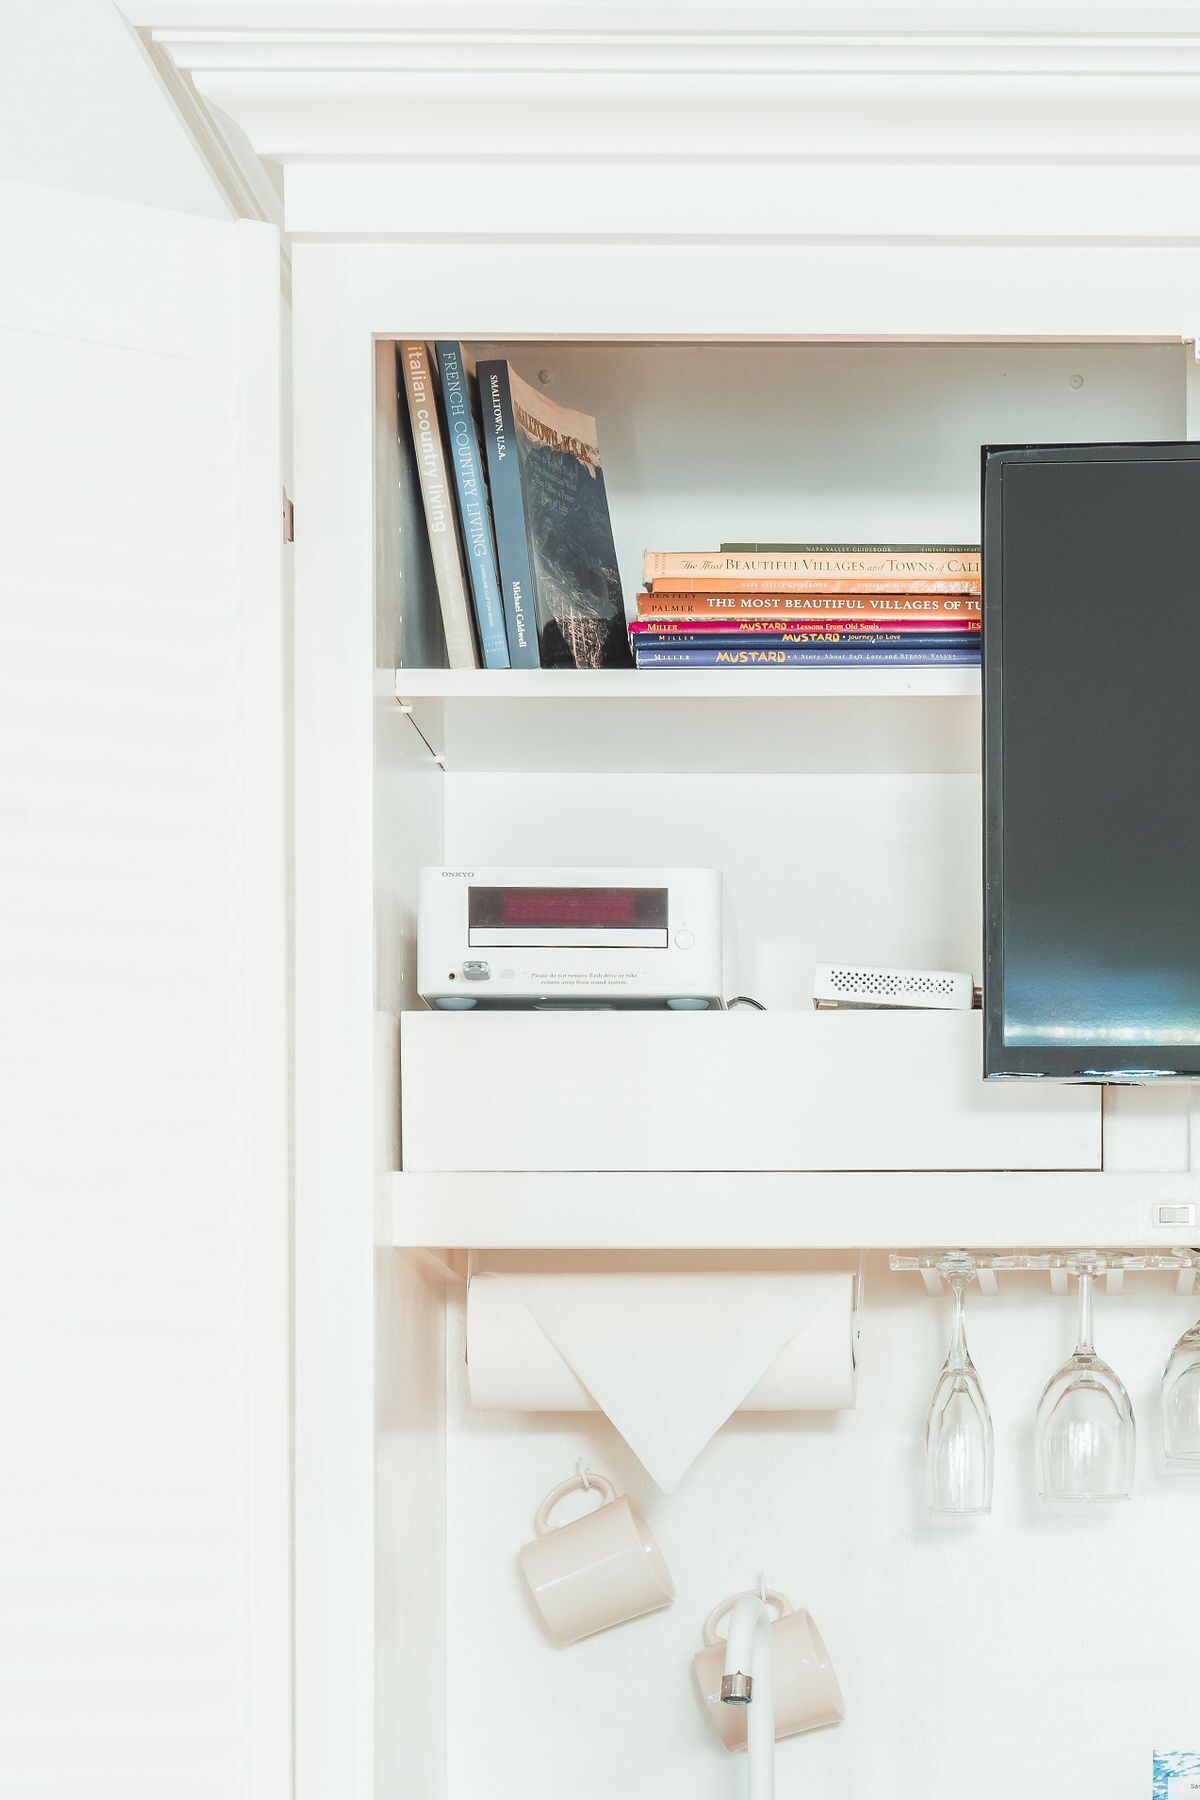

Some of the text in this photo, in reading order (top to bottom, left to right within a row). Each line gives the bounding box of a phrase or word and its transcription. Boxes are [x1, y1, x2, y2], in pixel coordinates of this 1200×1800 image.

[490, 374, 507, 461] SMALLTOWN, U.S.A.
[407, 346, 447, 533] italian country living
[443, 351, 488, 558] FRENCH COUNTRY LIVING
[681, 560, 698, 570] The
[699, 560, 723, 570] Most
[725, 559, 801, 571] BEAUTIFUL
[803, 559, 865, 571] VILLAGES
[866, 563, 885, 572] and
[886, 559, 935, 572] TOWNS
[936, 563, 945, 574] of
[706, 598, 736, 608] THE
[740, 599, 780, 608] MOST
[785, 599, 865, 609] BEAUTIFUL
[870, 600, 939, 610] VILLAGES
[943, 600, 961, 610] OF
[512, 580, 527, 649] Michael Caldwell
[647, 623, 678, 631] MILLER
[739, 622, 787, 631] MUSTARD
[797, 623, 824, 631] Lessons
[825, 623, 844, 631] From
[845, 623, 858, 631] Old
[860, 623, 880, 631] Souls
[781, 633, 840, 642] MUSTARD
[848, 634, 875, 642] Journey
[715, 651, 786, 663] MUSTARD
[849, 653, 863, 661] Soft
